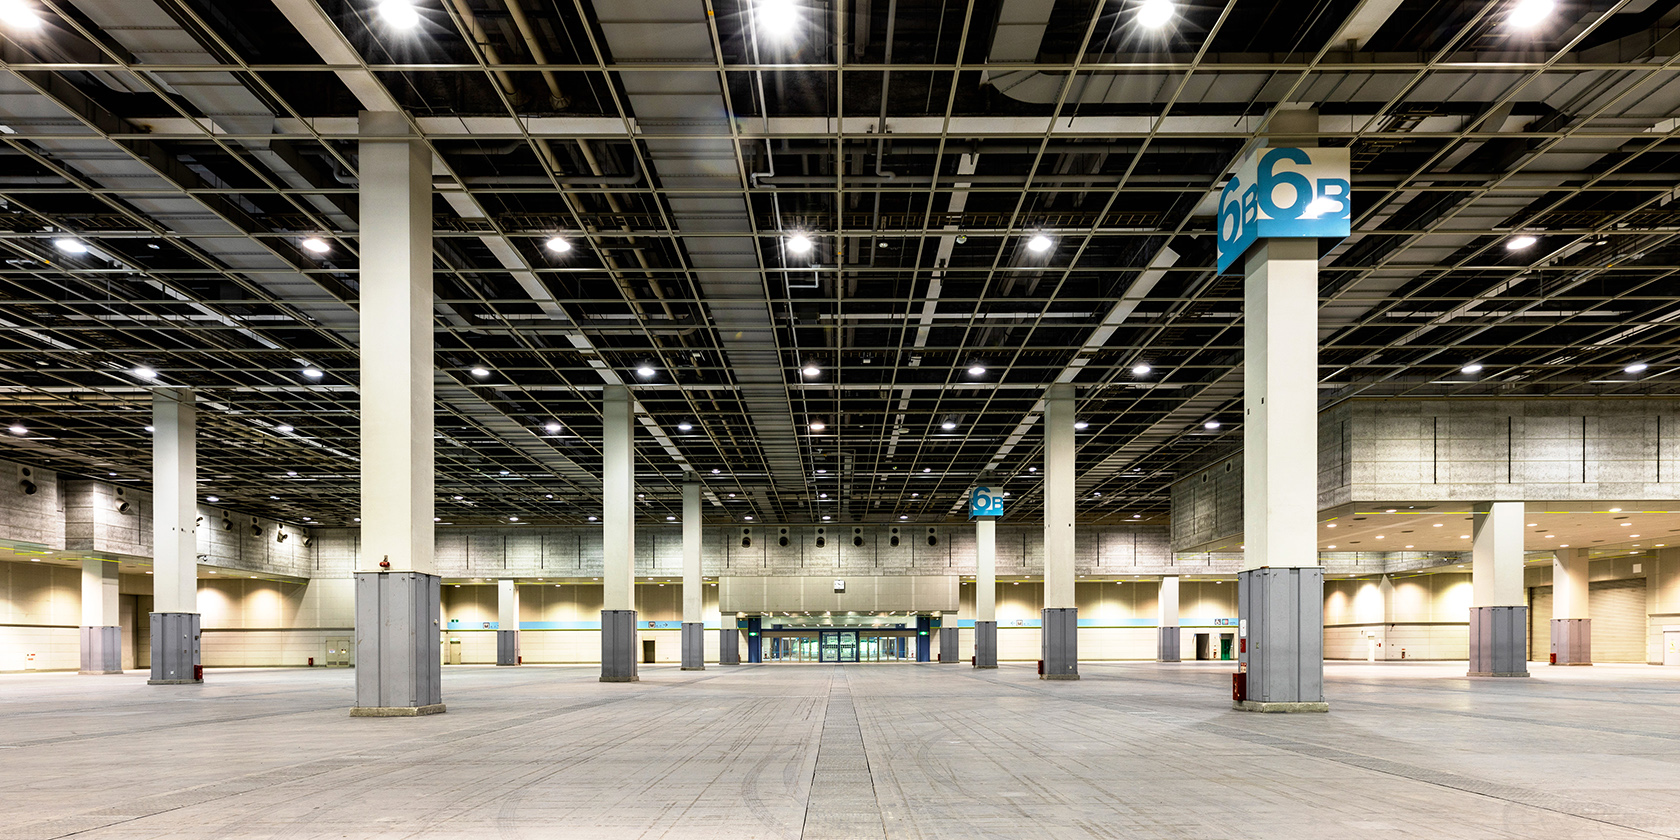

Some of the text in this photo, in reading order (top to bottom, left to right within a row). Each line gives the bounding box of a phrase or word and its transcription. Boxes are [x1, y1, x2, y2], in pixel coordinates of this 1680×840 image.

[1217, 176, 1258, 254] 6B
[1257, 147, 1350, 220] 6B
[973, 486, 1003, 511] 6B
